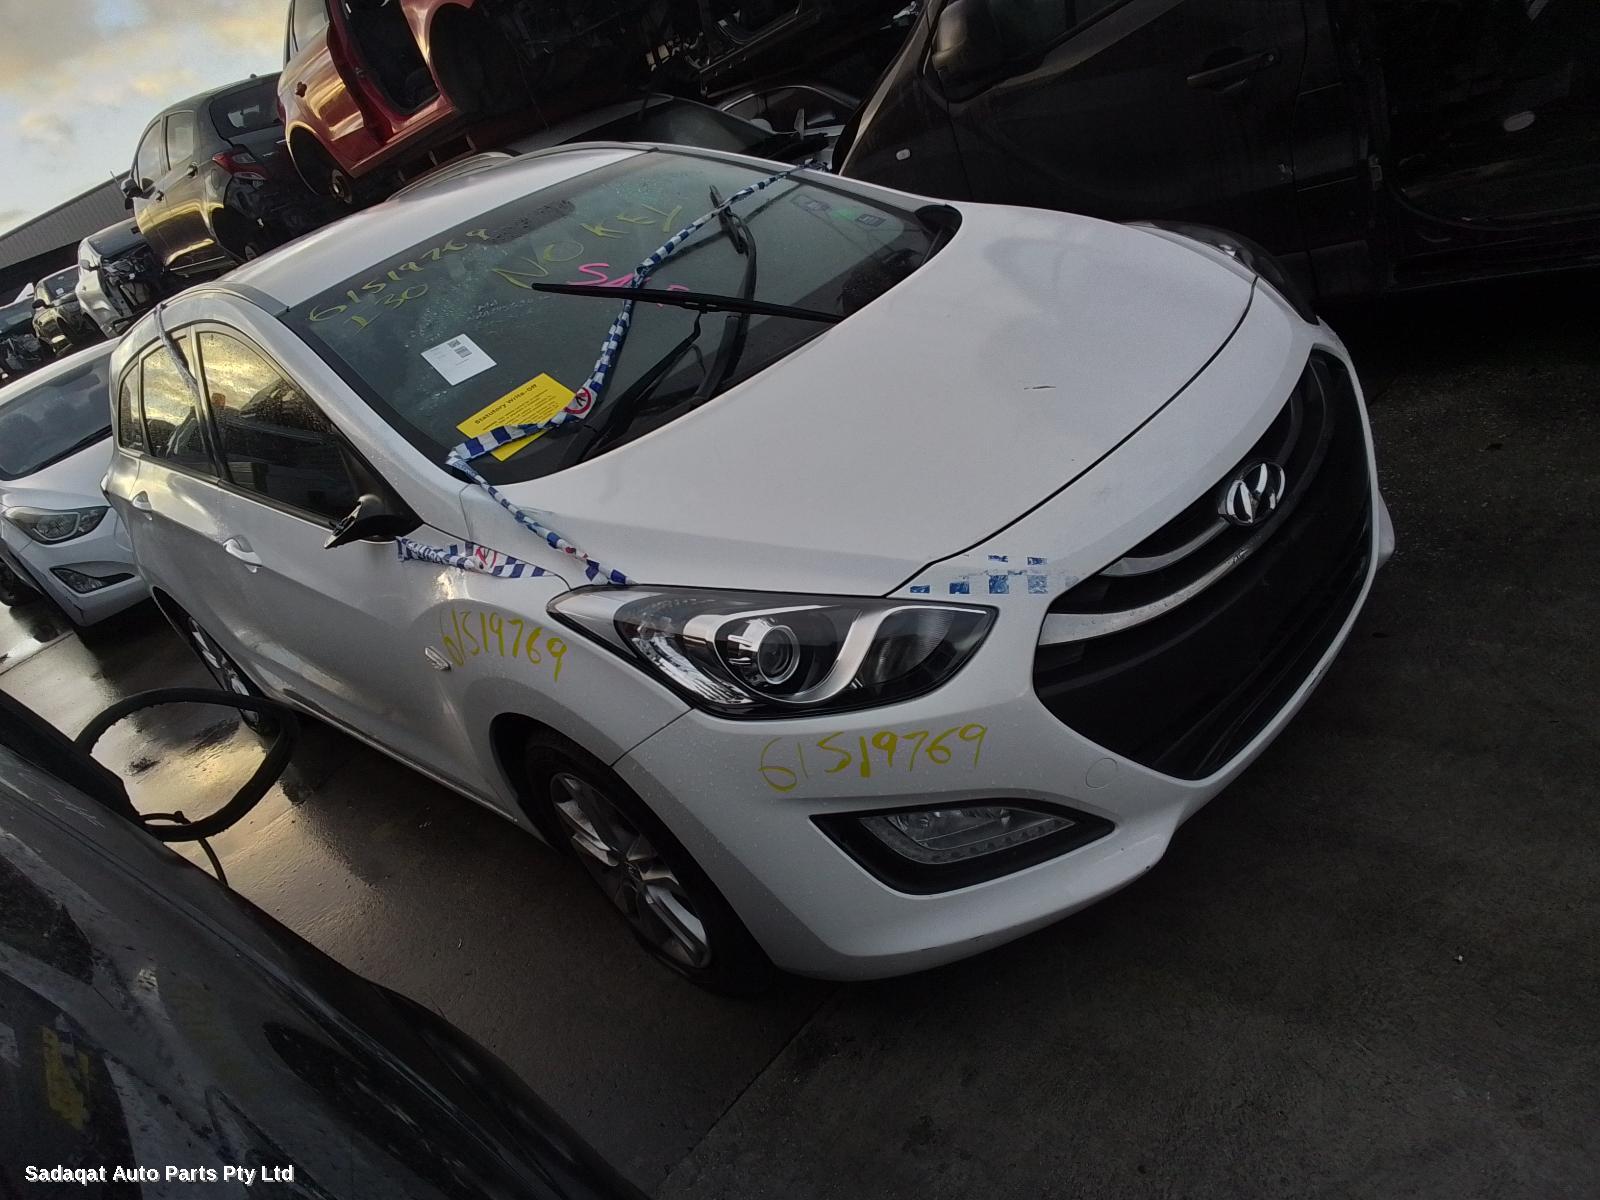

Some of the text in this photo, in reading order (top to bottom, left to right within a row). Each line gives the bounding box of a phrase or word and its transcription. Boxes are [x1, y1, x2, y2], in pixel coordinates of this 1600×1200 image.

[491, 241, 585, 290] NO
[579, 203, 682, 239] KEY
[474, 403, 506, 424] Statutory
[507, 383, 537, 404] Write-Off
[757, 723, 988, 792] 61519769
